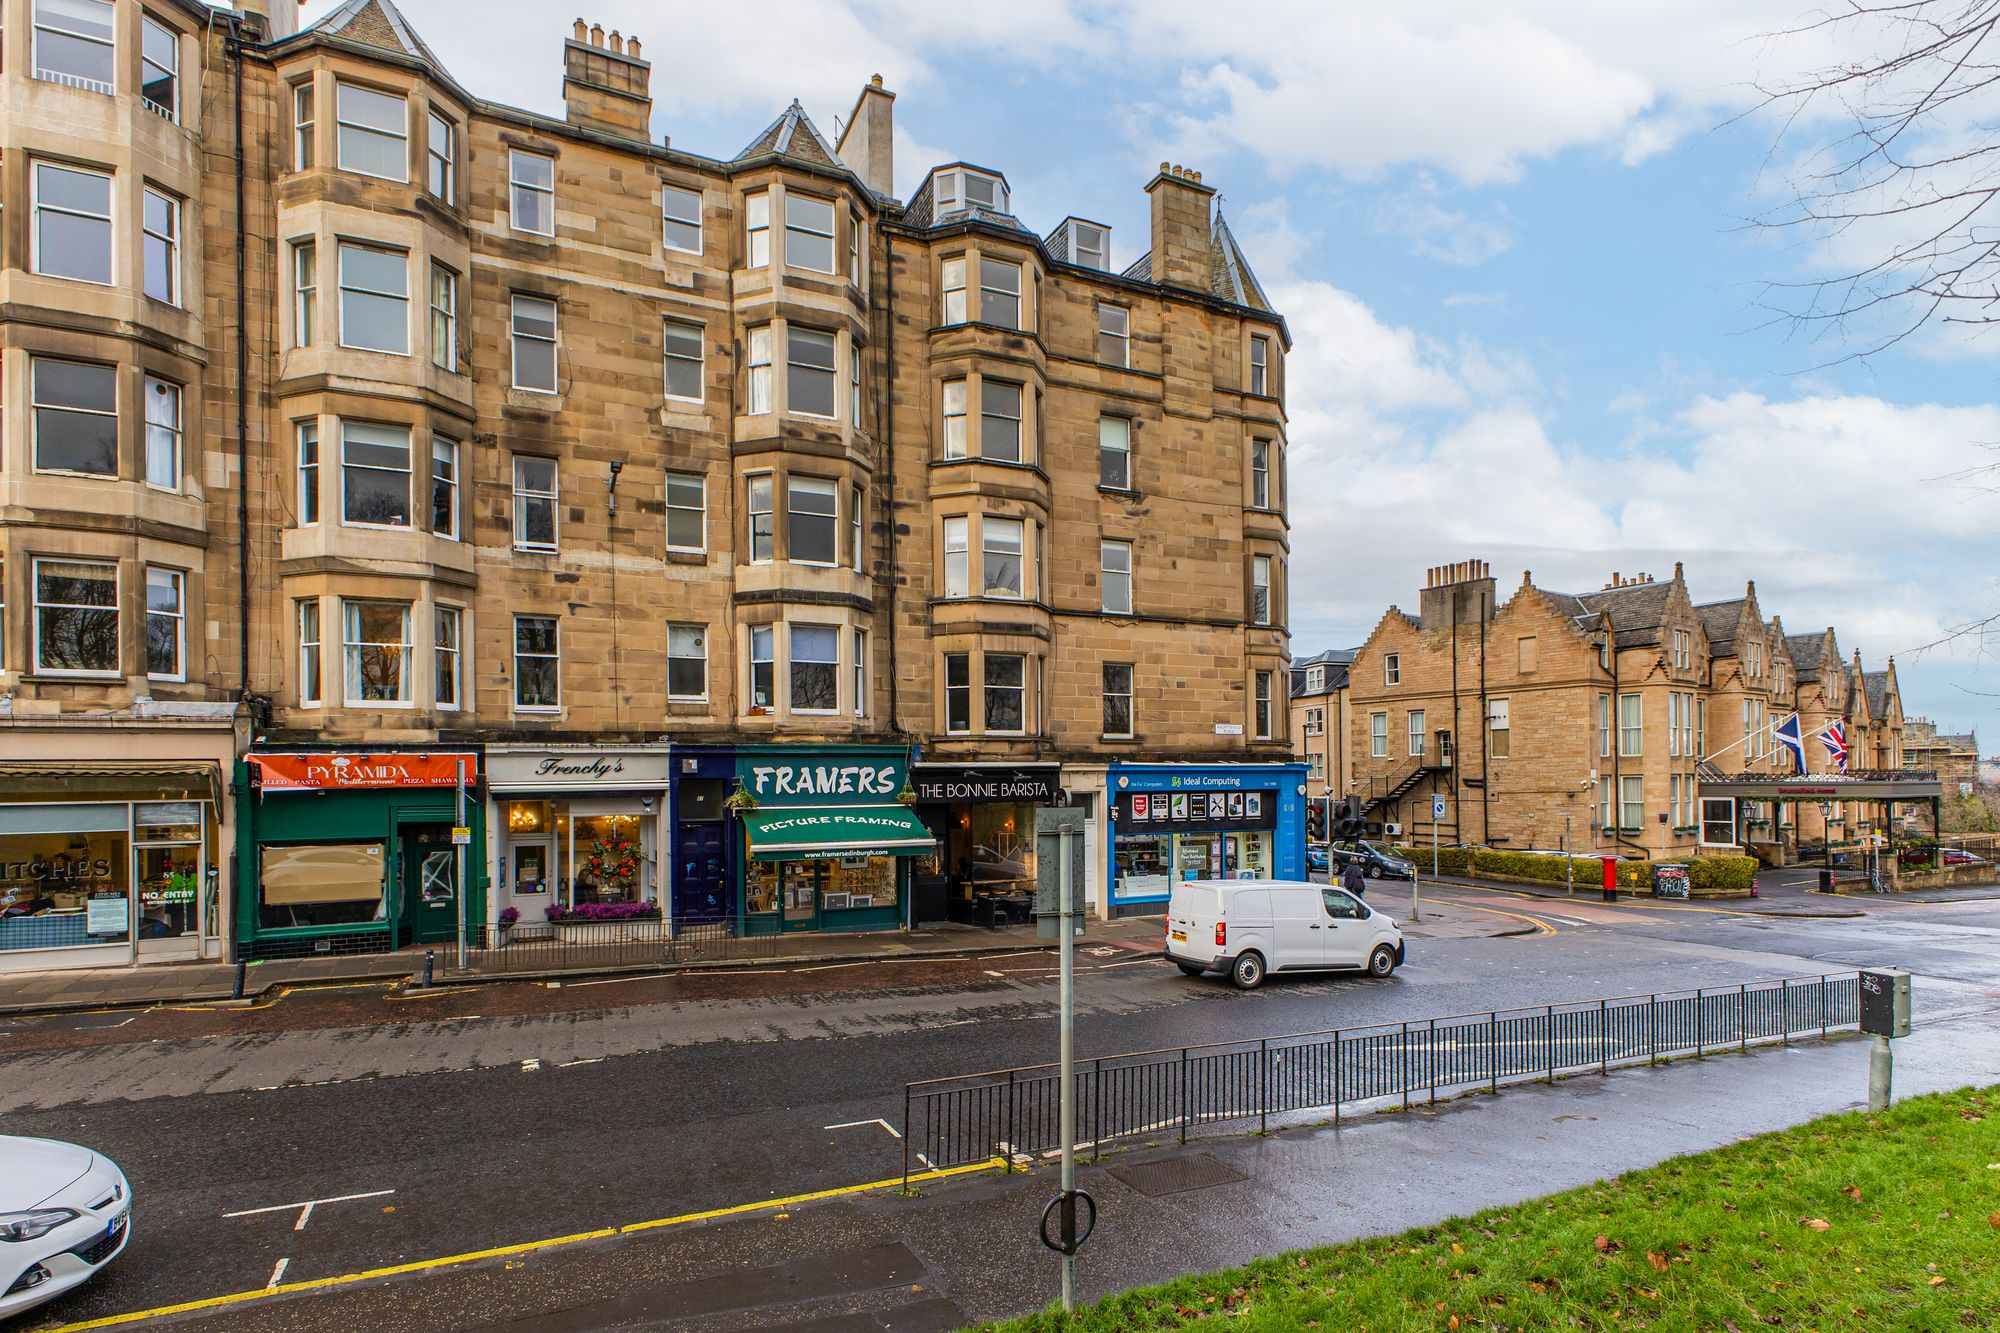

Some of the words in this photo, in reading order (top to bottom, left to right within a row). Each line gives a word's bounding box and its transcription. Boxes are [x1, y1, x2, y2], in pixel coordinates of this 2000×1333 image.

[308, 765, 409, 779] PYRAMIDA
[535, 757, 624, 779] Frenchy's
[753, 766, 896, 795] FRAMERS
[1183, 776, 1201, 786] Ideal
[1202, 776, 1241, 787] Computing
[920, 783, 943, 798] THE
[947, 783, 998, 798] BONNIE
[1001, 782, 1048, 797] BARISTA
[759, 815, 831, 833] PICTURE
[834, 815, 912, 830] FRAMING
[804, 849, 889, 859] www.framersedinburgh.com
[142, 891, 159, 900] NO
[163, 890, 194, 899] ENTRY
